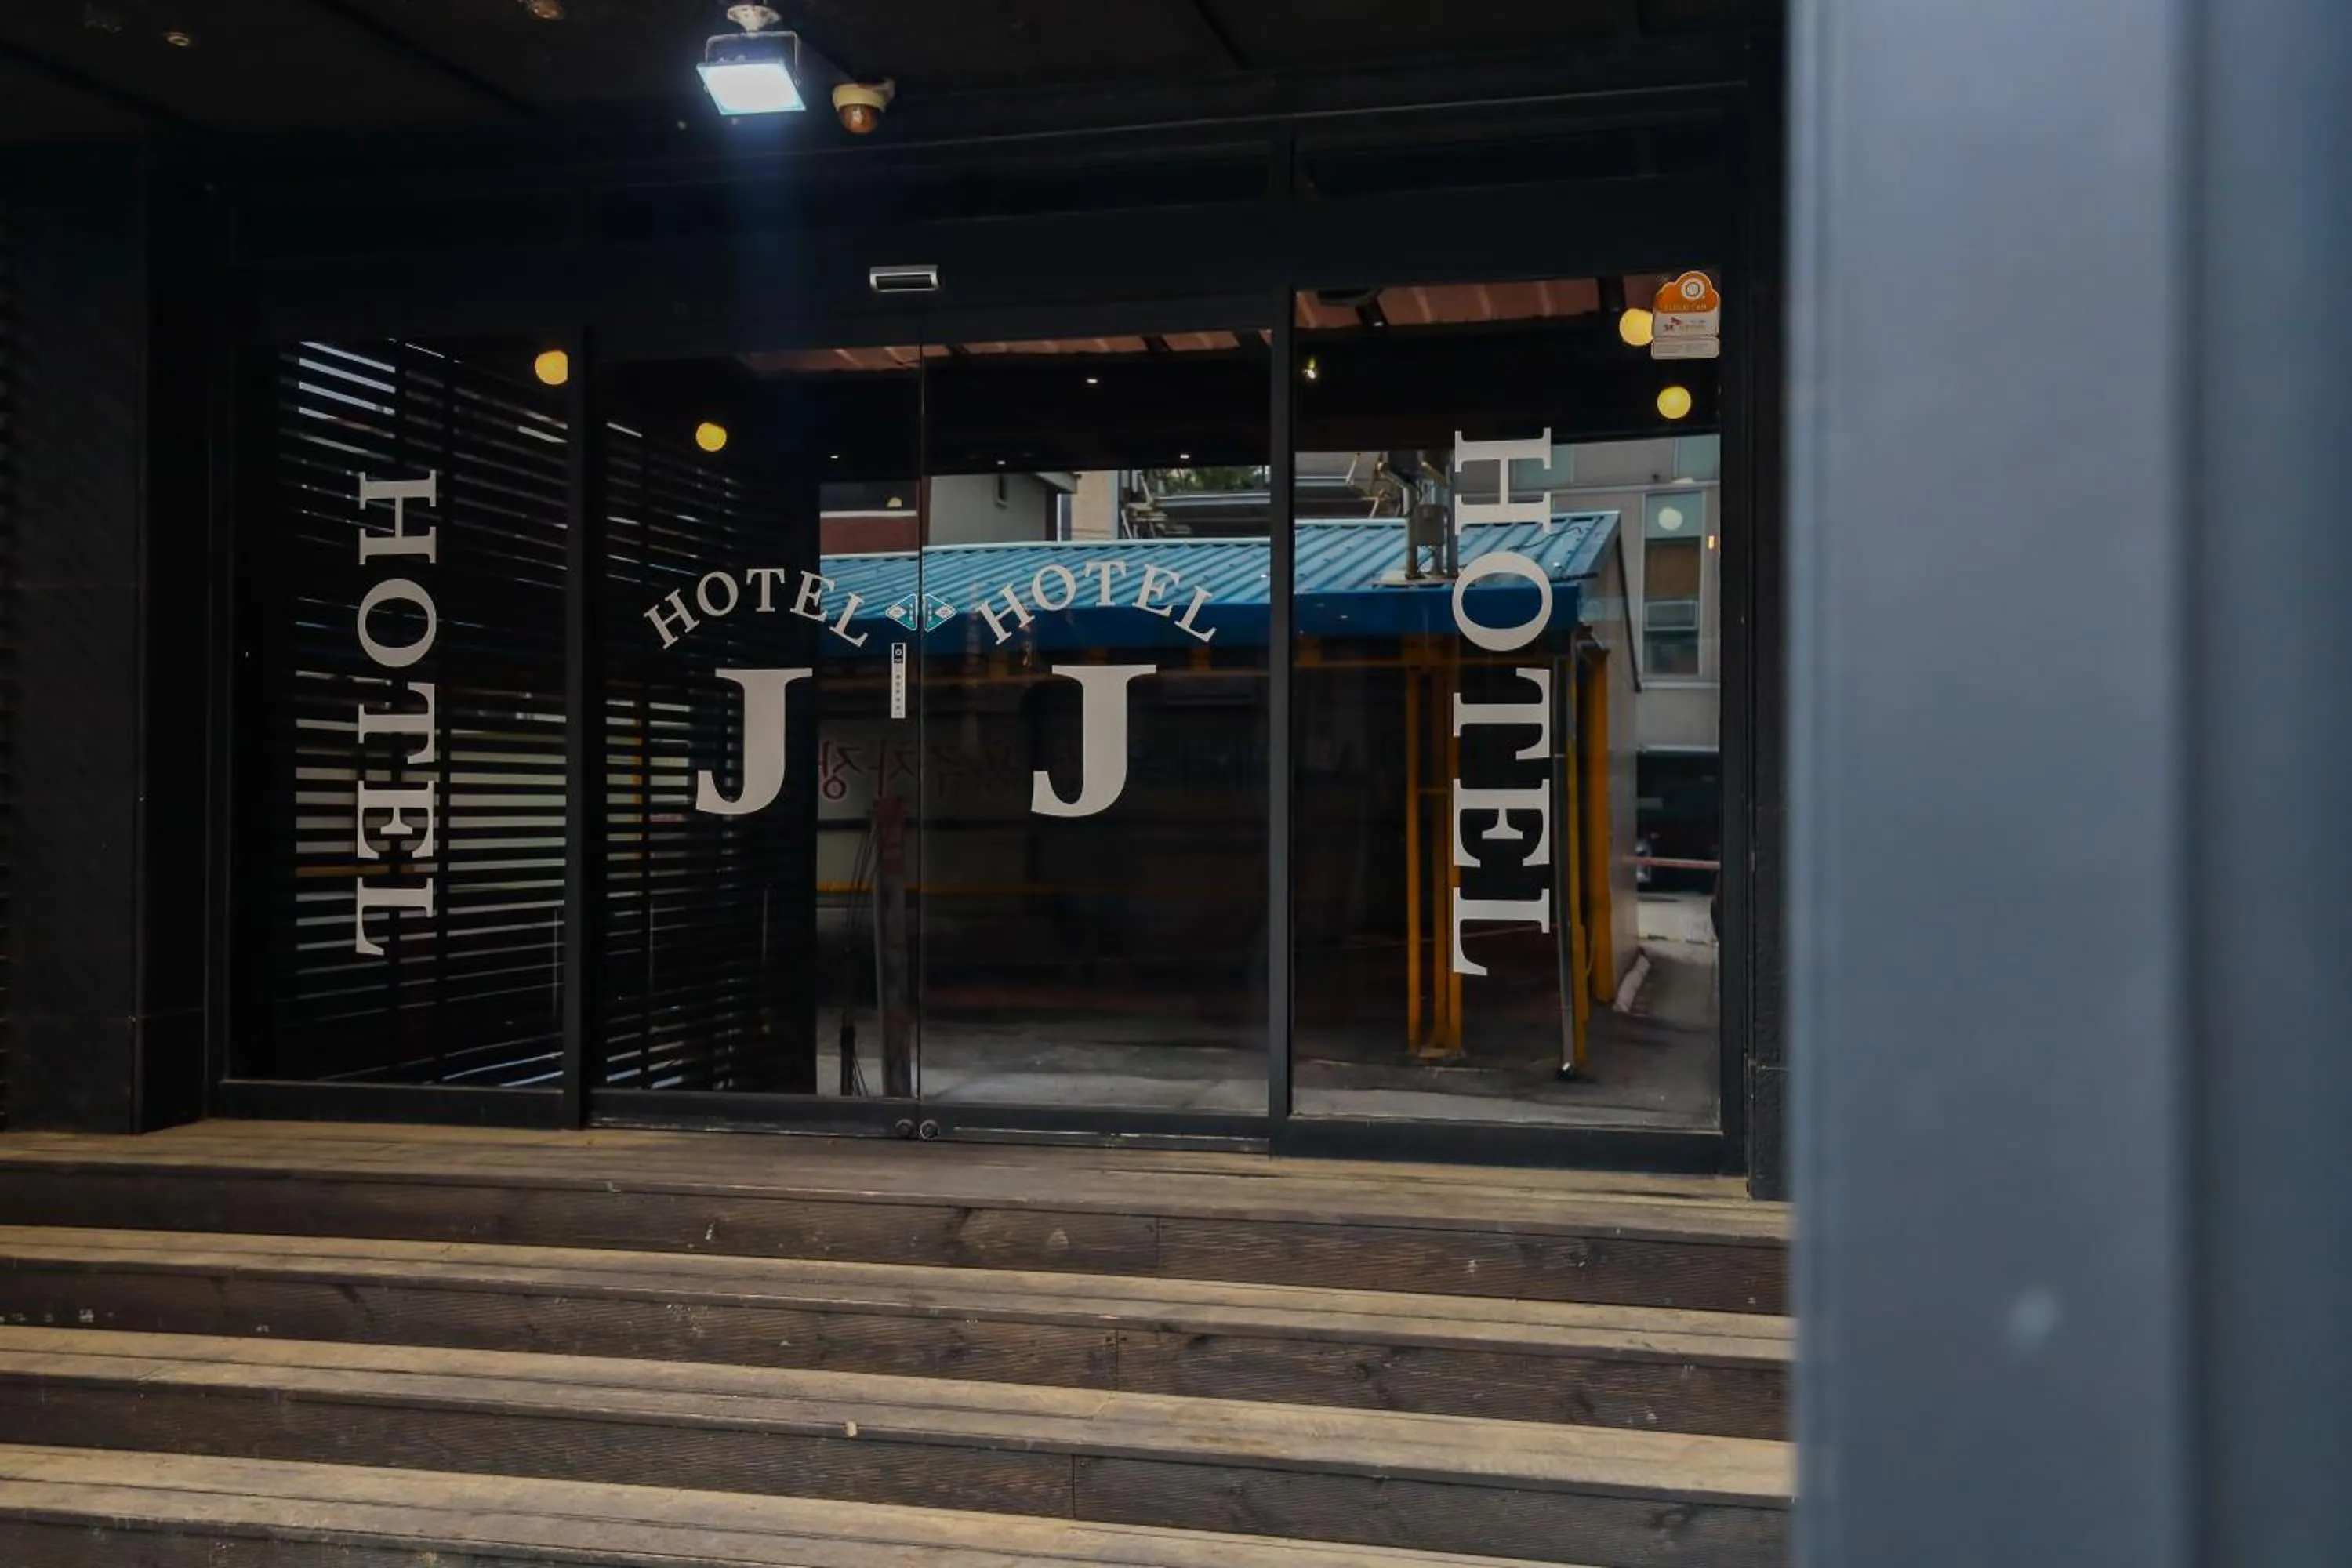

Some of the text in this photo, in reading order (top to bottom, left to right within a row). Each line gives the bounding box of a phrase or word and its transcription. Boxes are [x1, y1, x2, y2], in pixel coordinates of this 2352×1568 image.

[643, 568, 868, 650] HOTEL
[975, 560, 1217, 645] HOTEL
[356, 470, 437, 956] HOTEL
[695, 666, 814, 815] J
[1031, 664, 1156, 818] J
[1453, 426, 1552, 976] HOTEL
